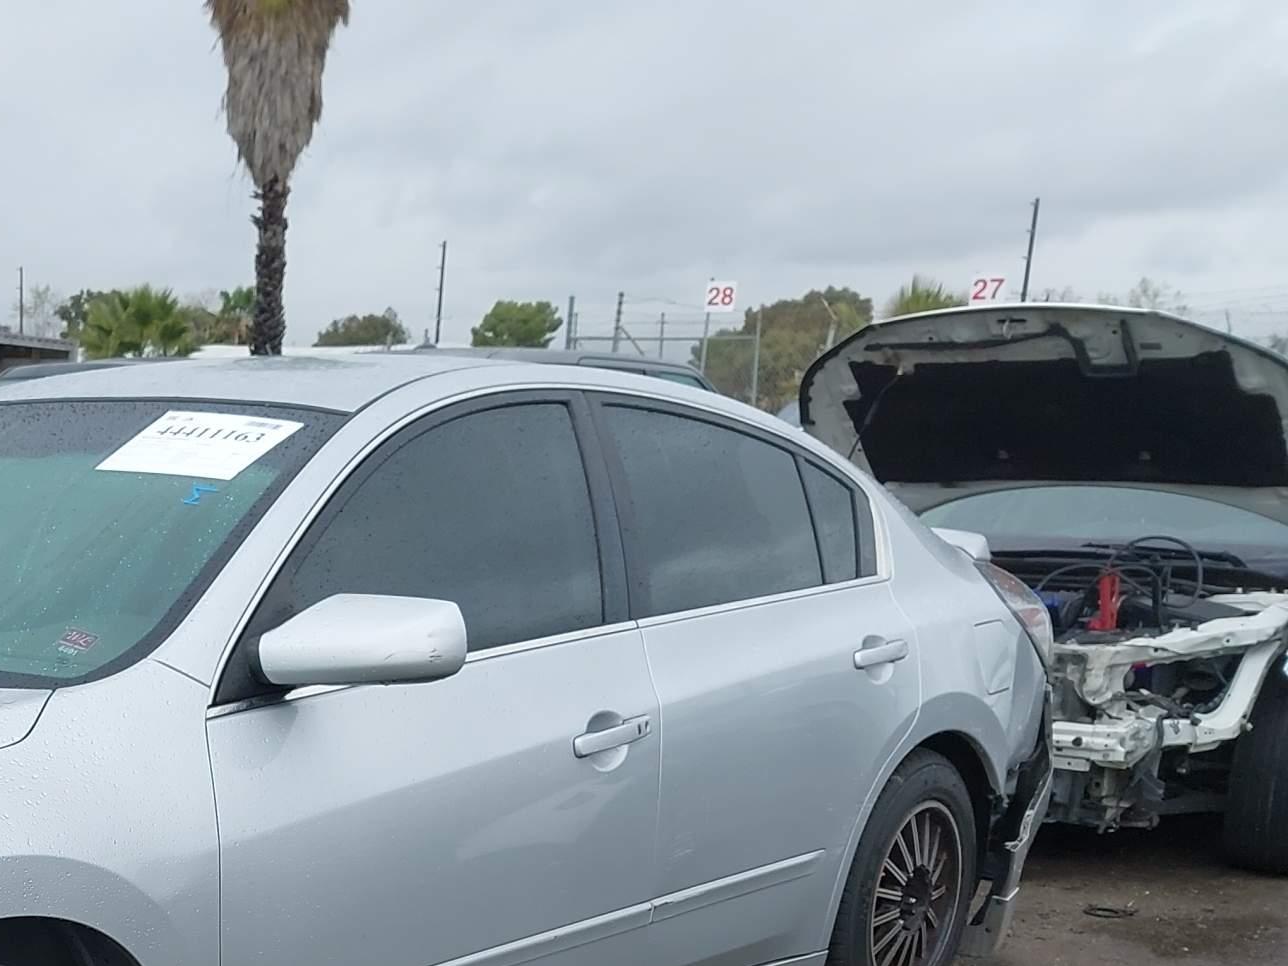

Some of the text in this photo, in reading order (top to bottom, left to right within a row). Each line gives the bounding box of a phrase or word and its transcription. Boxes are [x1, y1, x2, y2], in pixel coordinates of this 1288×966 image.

[706, 286, 735, 306] 28
[972, 278, 1005, 300] 27
[157, 426, 265, 443] 44411163
